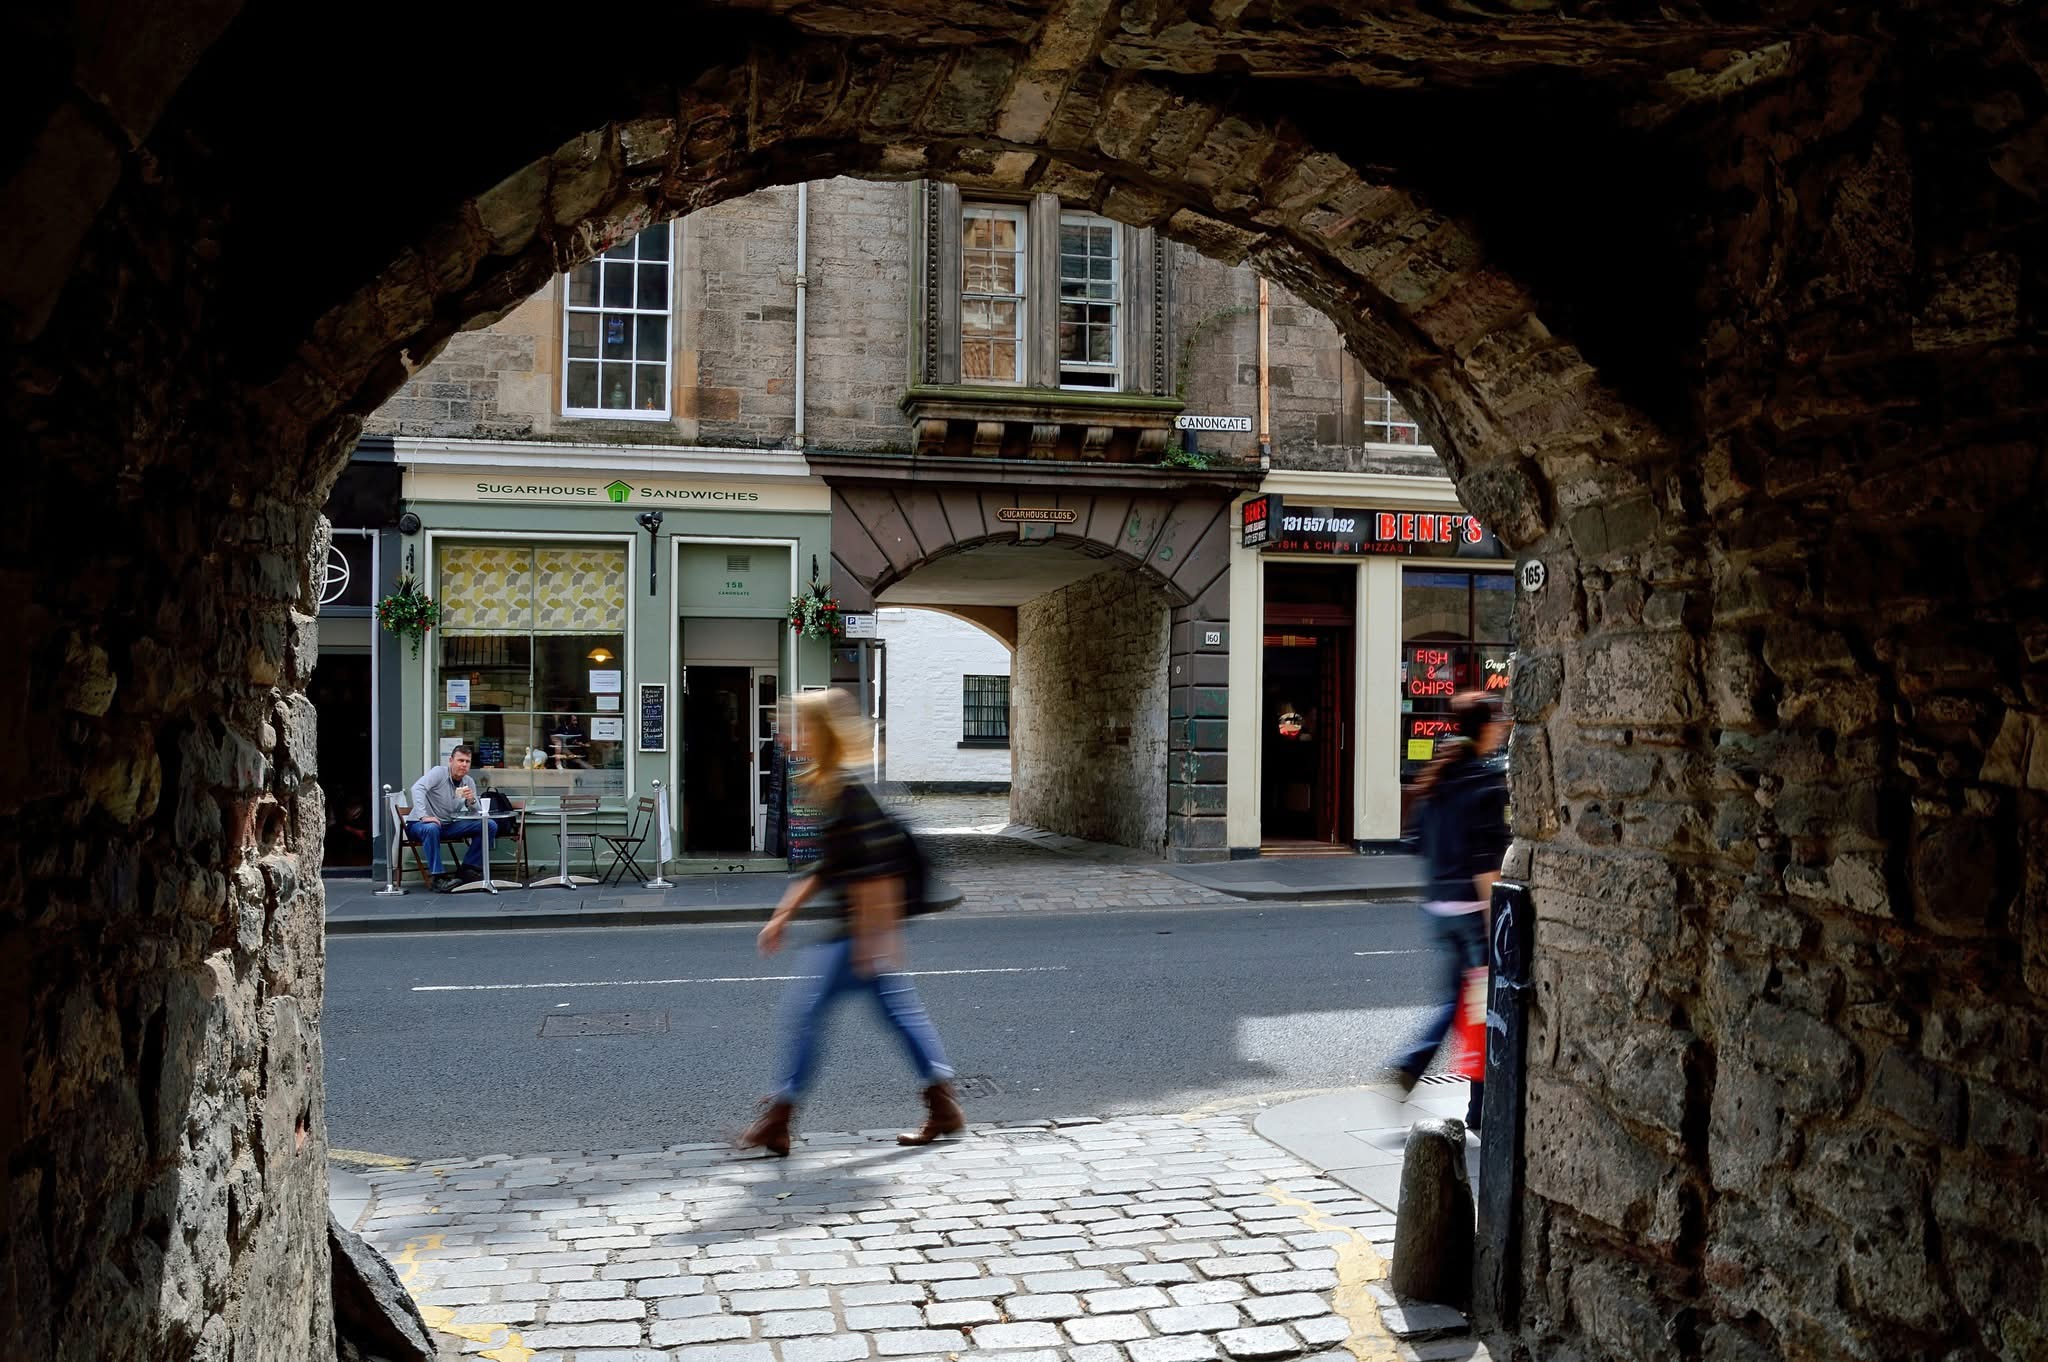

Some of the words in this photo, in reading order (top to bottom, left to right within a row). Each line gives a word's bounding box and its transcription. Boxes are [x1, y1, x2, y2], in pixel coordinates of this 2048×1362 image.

[1179, 416, 1247, 430] CANONGATE
[476, 483, 598, 496] SUGARHOUSE
[640, 487, 759, 501] SANDWICHES
[1002, 510, 1049, 519] SUGARHOUSE
[1049, 511, 1072, 520] CLOSE
[1303, 517, 1326, 532] 557
[1326, 518, 1355, 533] 1092
[1375, 512, 1483, 544] BENE'S
[1303, 541, 1310, 550] &
[1315, 541, 1350, 551] CHIPS
[1363, 543, 1404, 553] PIZZAS
[1524, 565, 1541, 586] 165
[726, 581, 743, 589] 158
[1416, 649, 1448, 665] FISH
[1427, 666, 1436, 680] &
[1411, 680, 1455, 696] CHIPS
